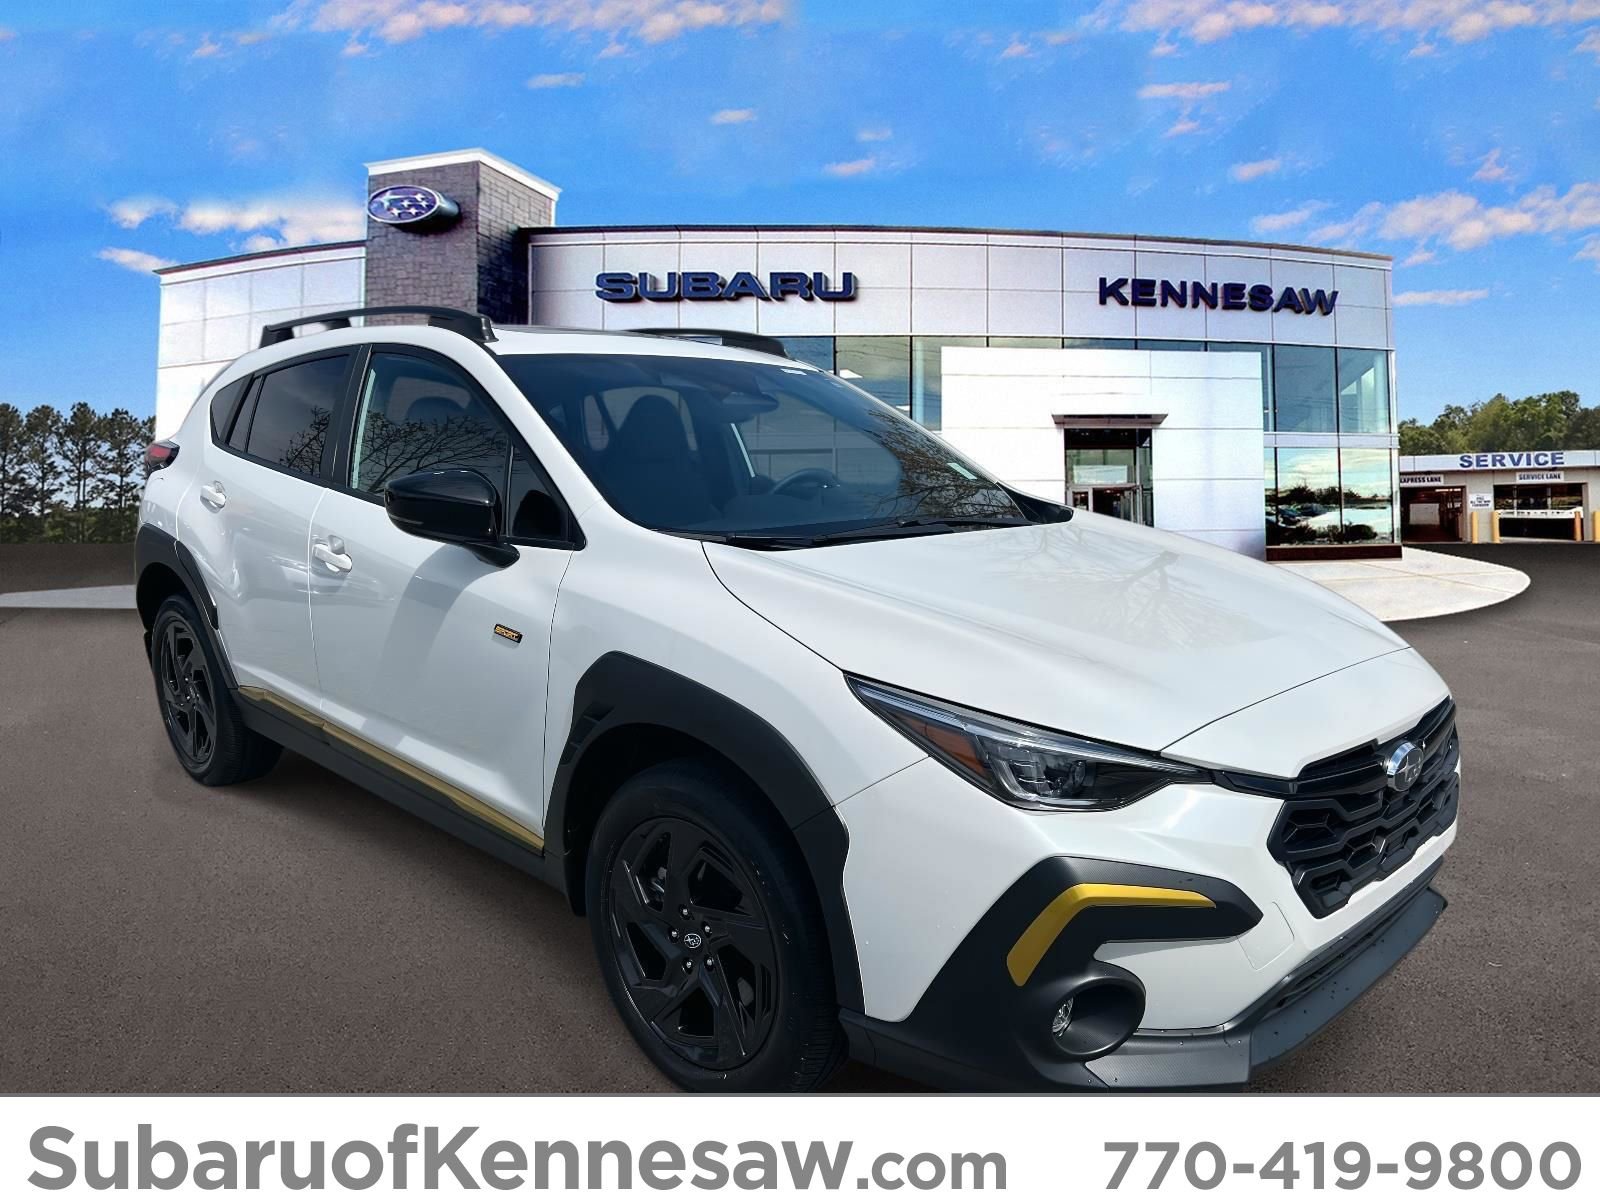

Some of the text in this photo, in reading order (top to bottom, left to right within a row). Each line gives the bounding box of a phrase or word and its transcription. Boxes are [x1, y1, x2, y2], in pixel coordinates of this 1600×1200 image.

[595, 271, 858, 301] SUBARU
[1098, 277, 1339, 316] KENNESAW
[1459, 451, 1565, 468] SERVICE
[1427, 475, 1442, 483] LANE
[1518, 472, 1562, 481] SERVICE LANE
